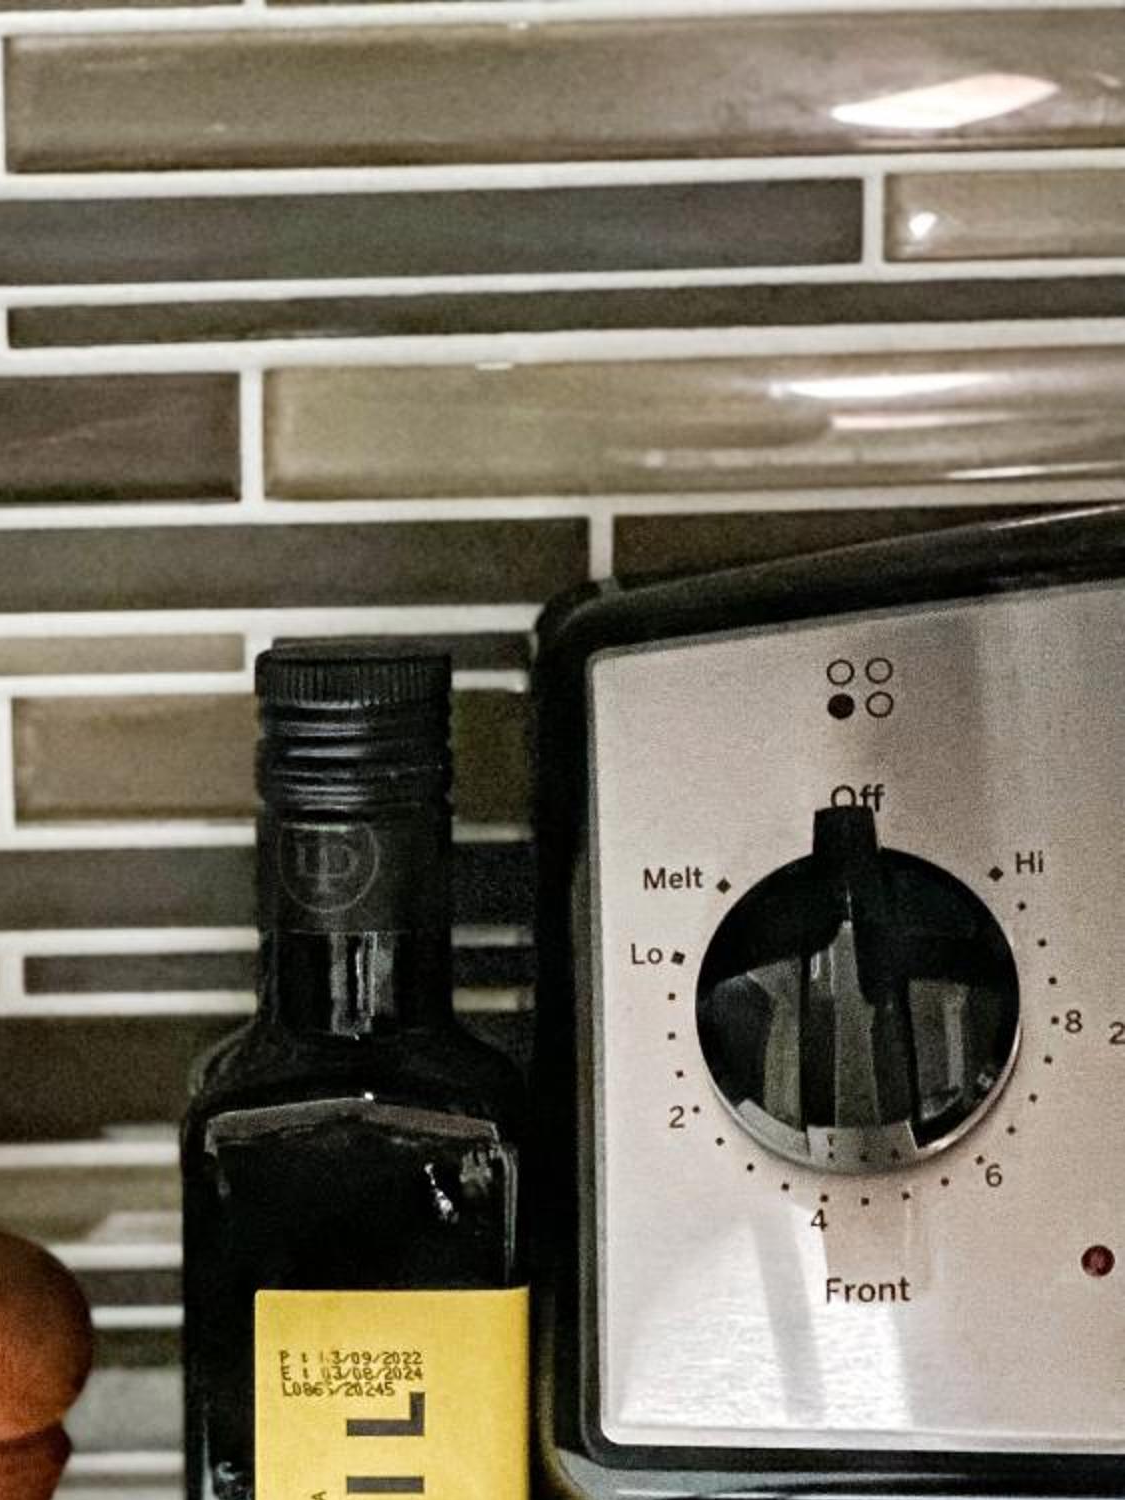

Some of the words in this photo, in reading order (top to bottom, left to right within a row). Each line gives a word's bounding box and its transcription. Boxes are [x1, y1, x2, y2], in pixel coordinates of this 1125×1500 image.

[829, 783, 886, 812] Off
[1014, 850, 1045, 875] Hi
[642, 866, 703, 890] Melt
[630, 943, 663, 965] Lo
[1064, 1009, 1084, 1034] 8
[669, 1104, 686, 1129] 2
[984, 1162, 1004, 1188] 6
[809, 1207, 829, 1232] 4
[825, 1277, 911, 1303] Front
